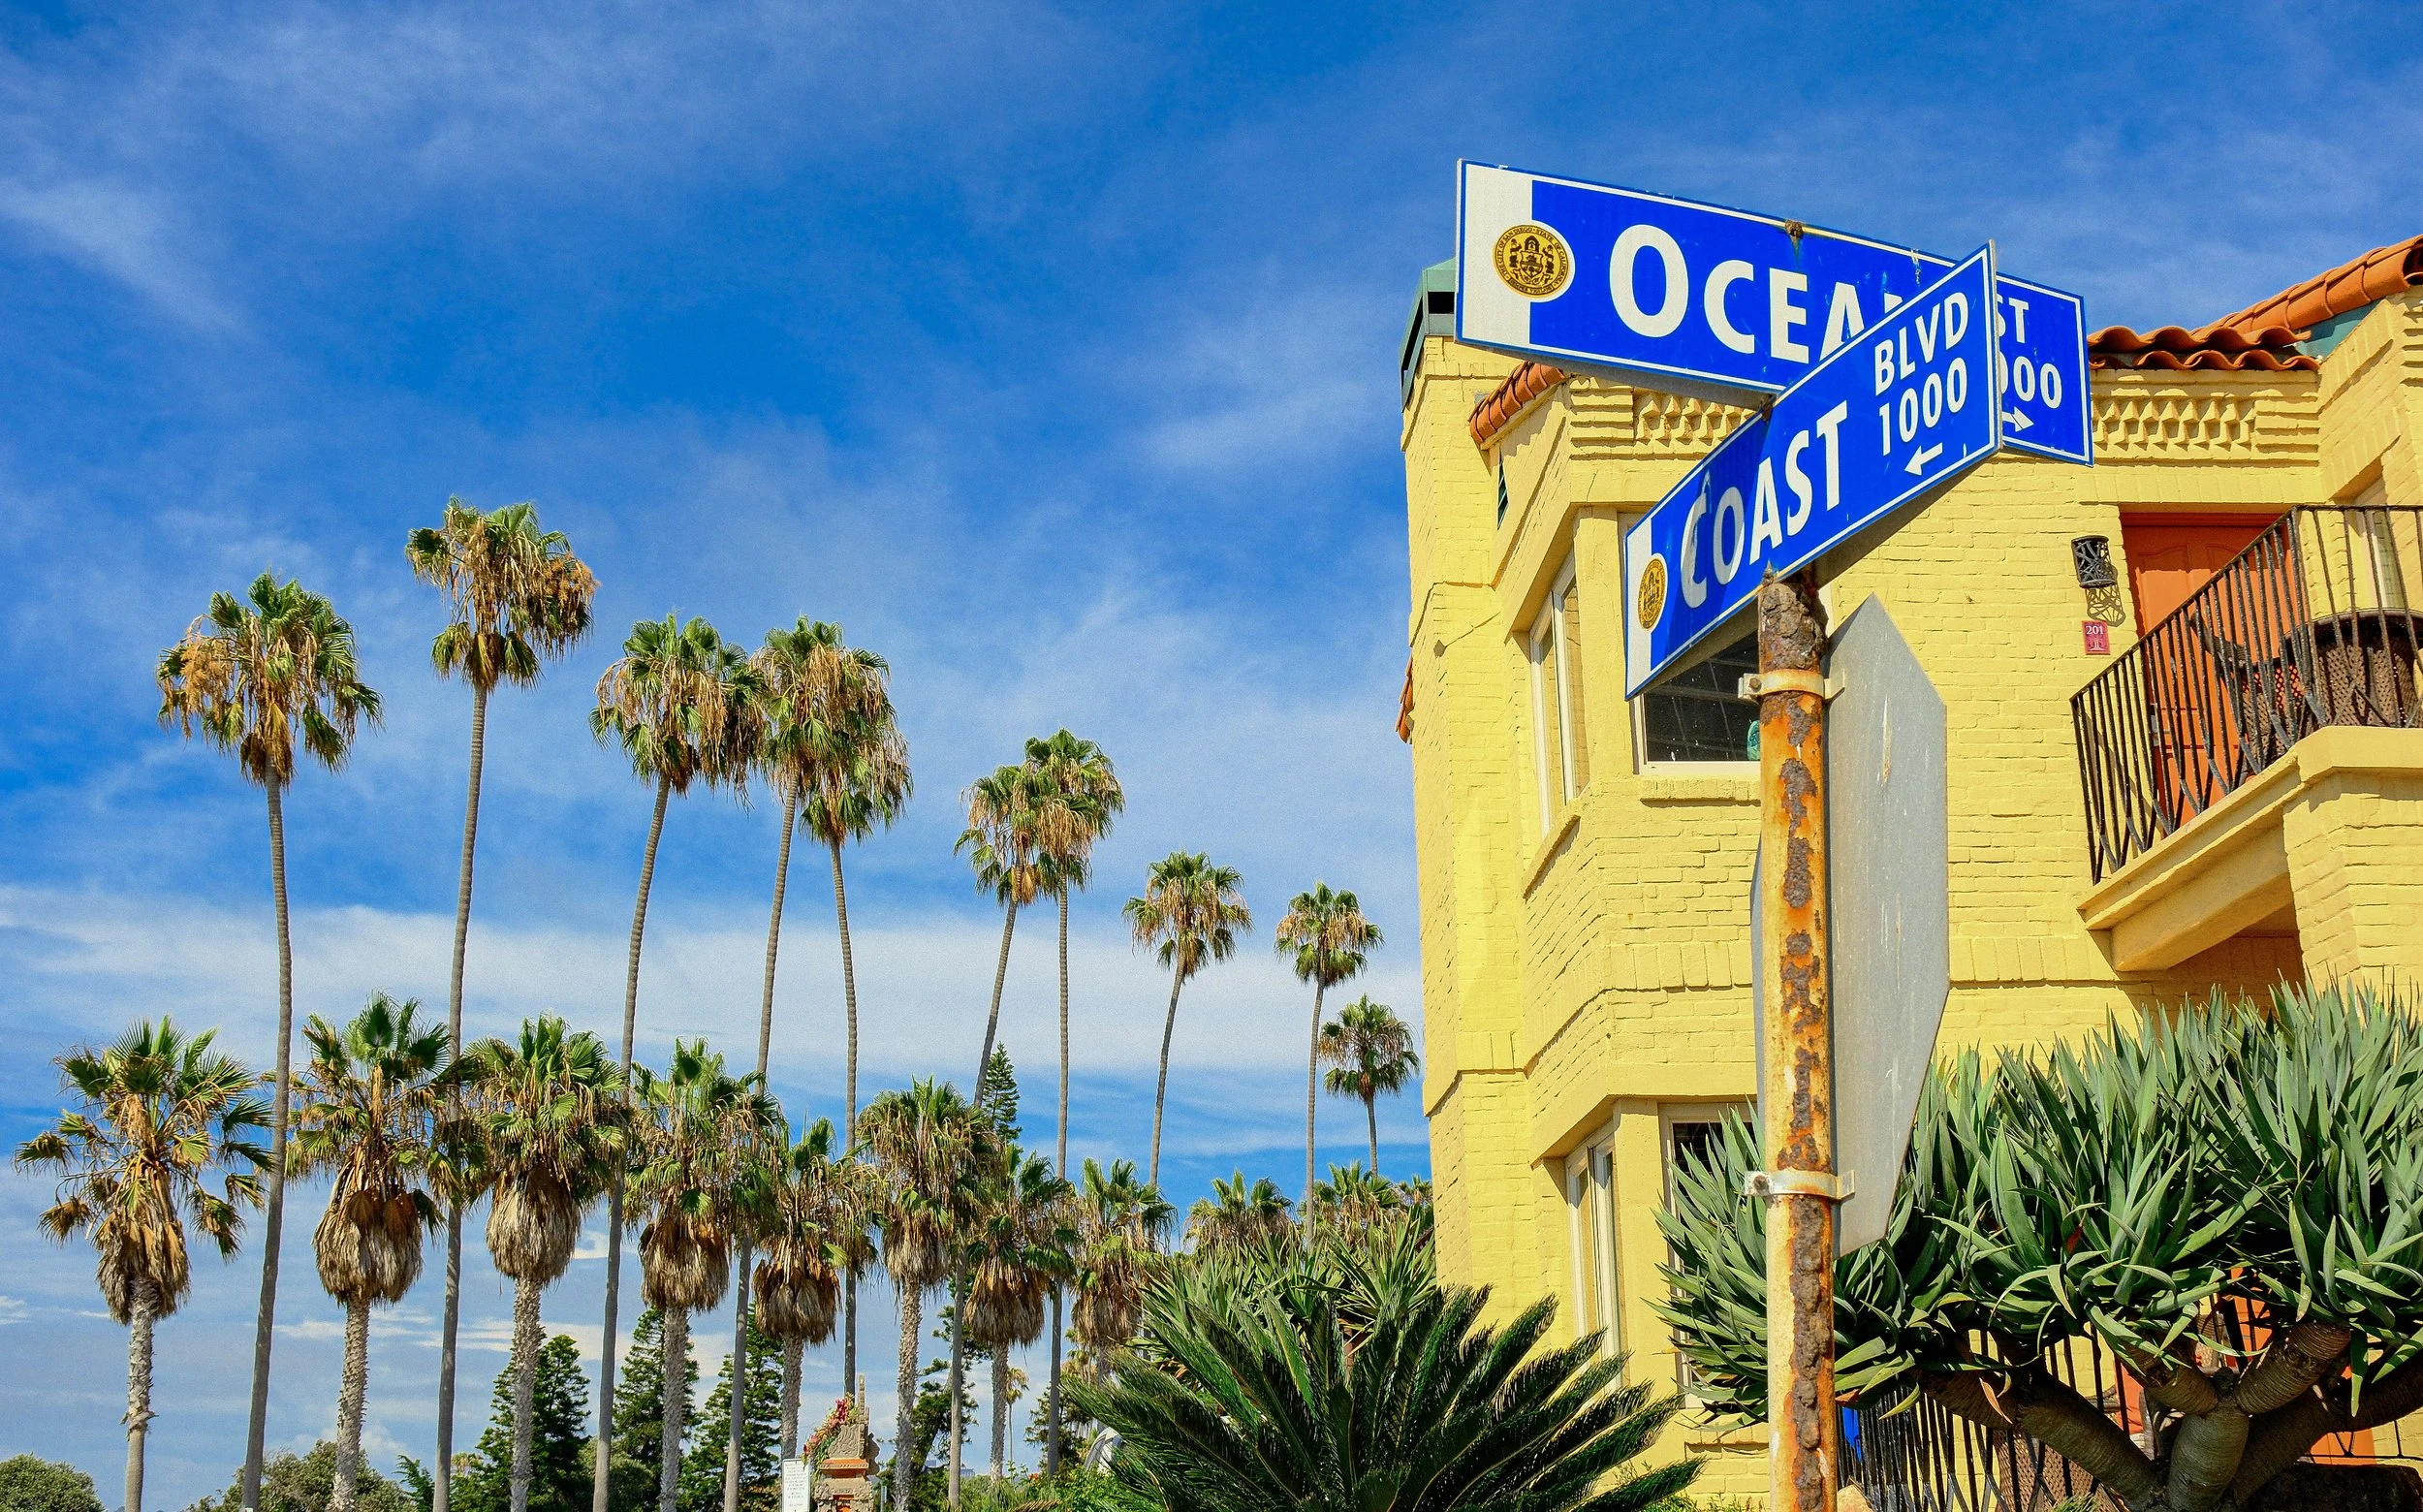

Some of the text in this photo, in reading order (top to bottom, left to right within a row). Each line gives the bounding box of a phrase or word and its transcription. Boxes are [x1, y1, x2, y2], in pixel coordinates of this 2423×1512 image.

[1609, 224, 1903, 363] OCEA
[1874, 292, 1968, 396] BLVD
[1878, 357, 1967, 457] 1000
[1681, 399, 1847, 609] COAST
[2086, 625, 2104, 635] 201
